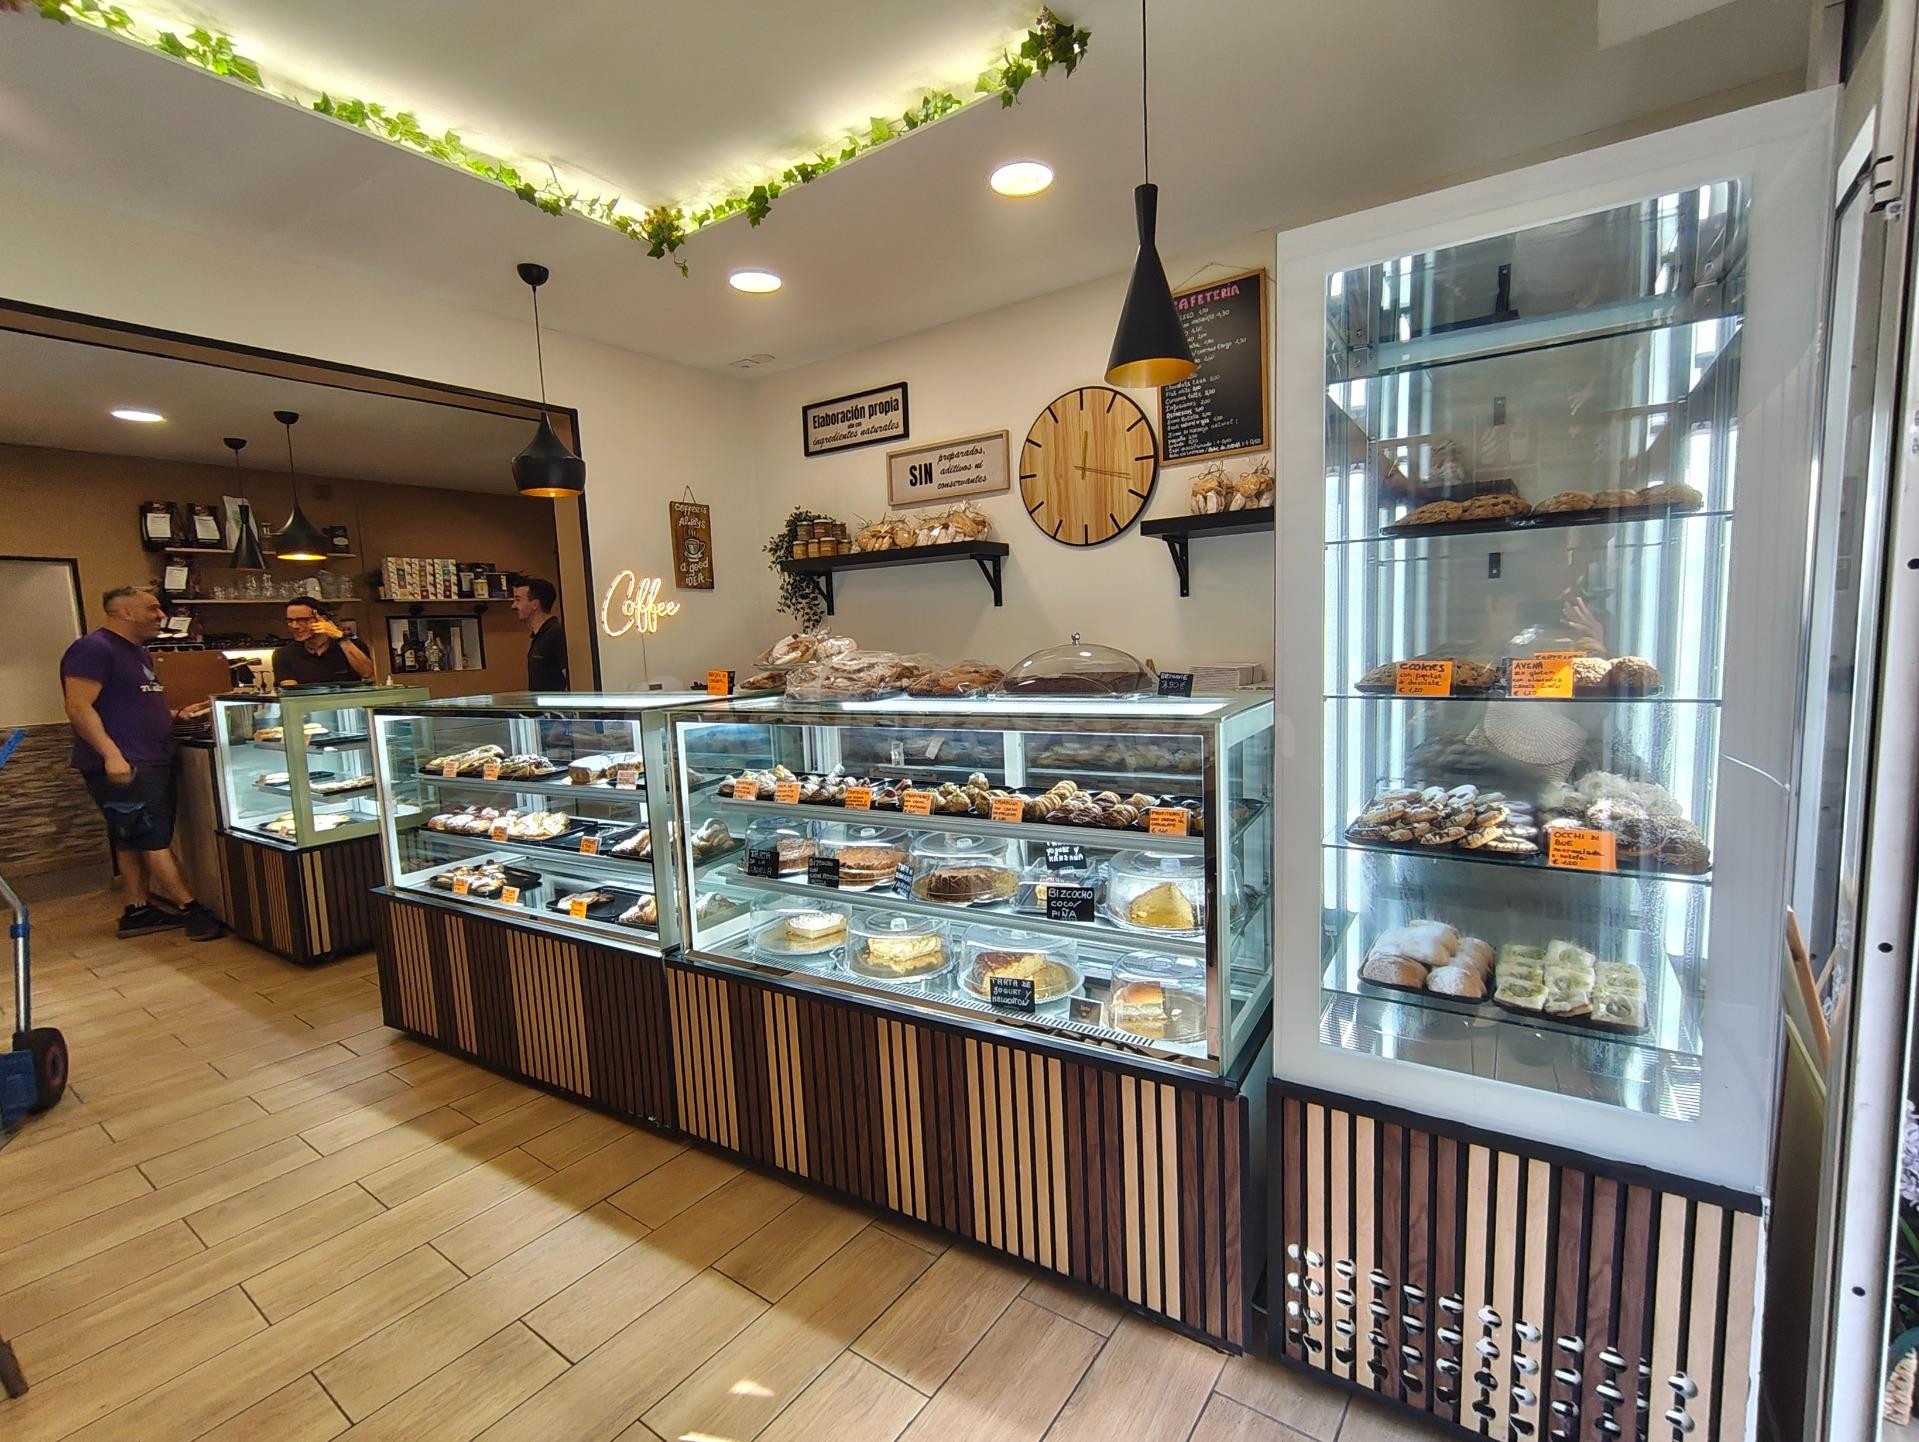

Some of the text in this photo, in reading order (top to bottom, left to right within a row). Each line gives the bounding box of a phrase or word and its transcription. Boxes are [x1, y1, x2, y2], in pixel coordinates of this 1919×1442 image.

[813, 397, 900, 430] Elaboración propia
[812, 419, 900, 448] ingredientes naturales
[909, 462, 933, 487] SIN
[940, 459, 984, 477] aditivos ni
[937, 474, 987, 490] conservantes
[680, 557, 709, 577] a good
[601, 569, 681, 637] Coffee
[1514, 662, 1544, 670] AVENA
[1553, 831, 1585, 840] OCCHI
[1048, 888, 1093, 899] BIZCOCHO
[1051, 907, 1077, 918] PIÑA
[991, 978, 1018, 987] TARTA
